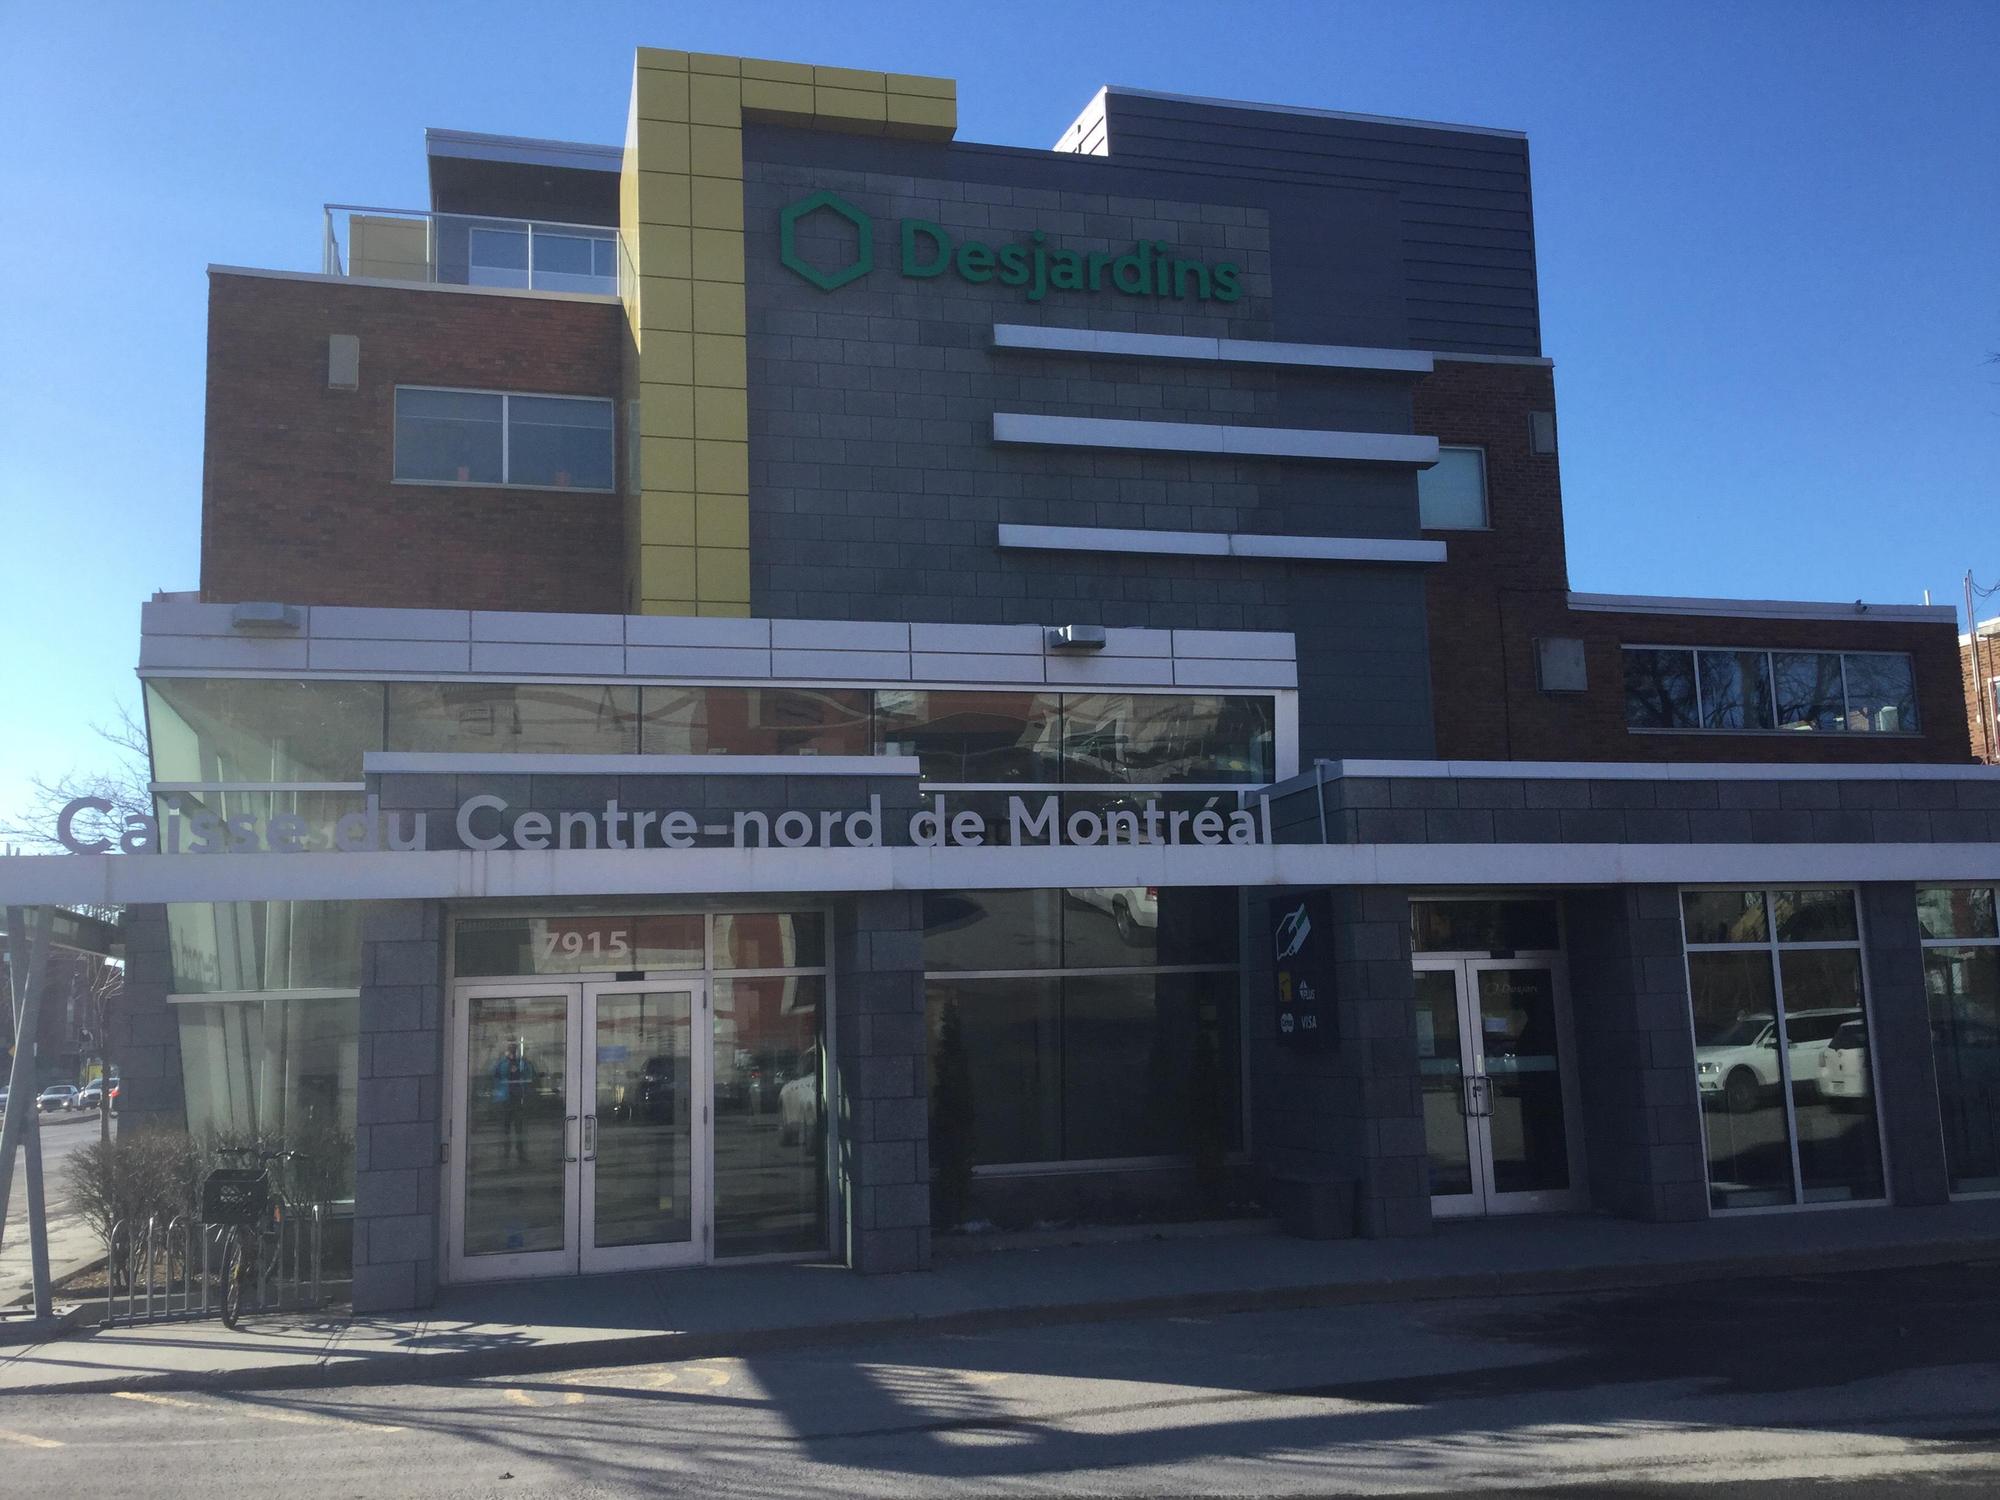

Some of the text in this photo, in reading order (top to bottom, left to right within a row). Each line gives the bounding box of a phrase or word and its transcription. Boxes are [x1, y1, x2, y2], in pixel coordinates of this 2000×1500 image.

[901, 217, 1243, 301] Desjardins
[57, 794, 1272, 854] Caisse du Centre-nord de Montréal
[541, 931, 628, 960] 7915
[1301, 1015, 1317, 1030] VISA
